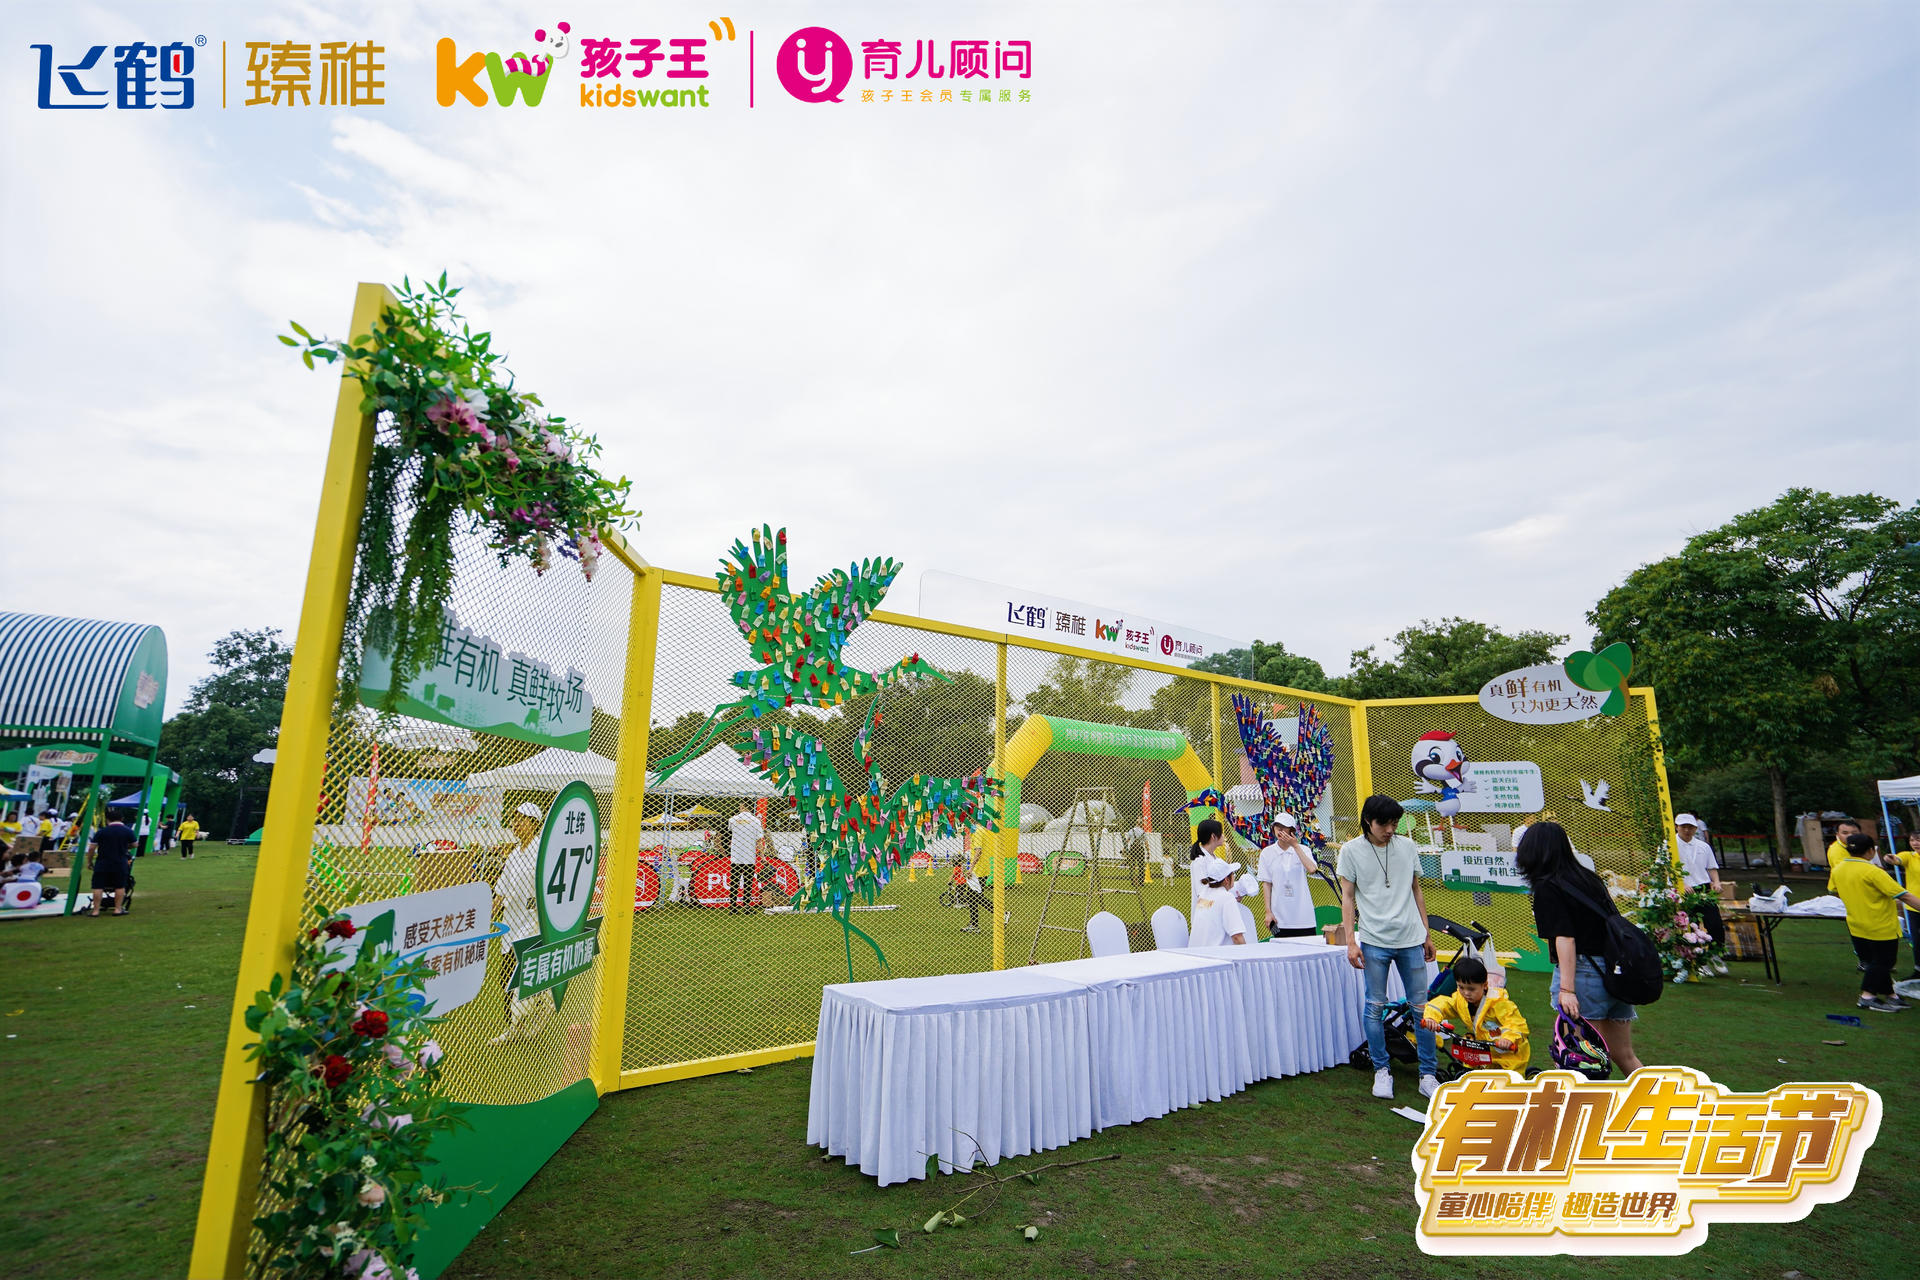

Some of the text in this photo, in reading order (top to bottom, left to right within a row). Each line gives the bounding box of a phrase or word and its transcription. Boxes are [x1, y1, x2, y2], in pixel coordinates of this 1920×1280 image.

[1007, 601, 1046, 629] 飞鹤
[1055, 611, 1086, 636] 臻稚
[1126, 629, 1150, 645] 孩子王
[507, 658, 584, 724] 真鲜牧场
[1489, 676, 1562, 698] 真鲜有机
[1511, 691, 1598, 715] 只为更天然
[564, 811, 586, 835] 北纬
[1488, 867, 1528, 878] 有机生
[404, 908, 477, 950] 感受天然之美
[522, 936, 596, 987] 专属有机奶源
